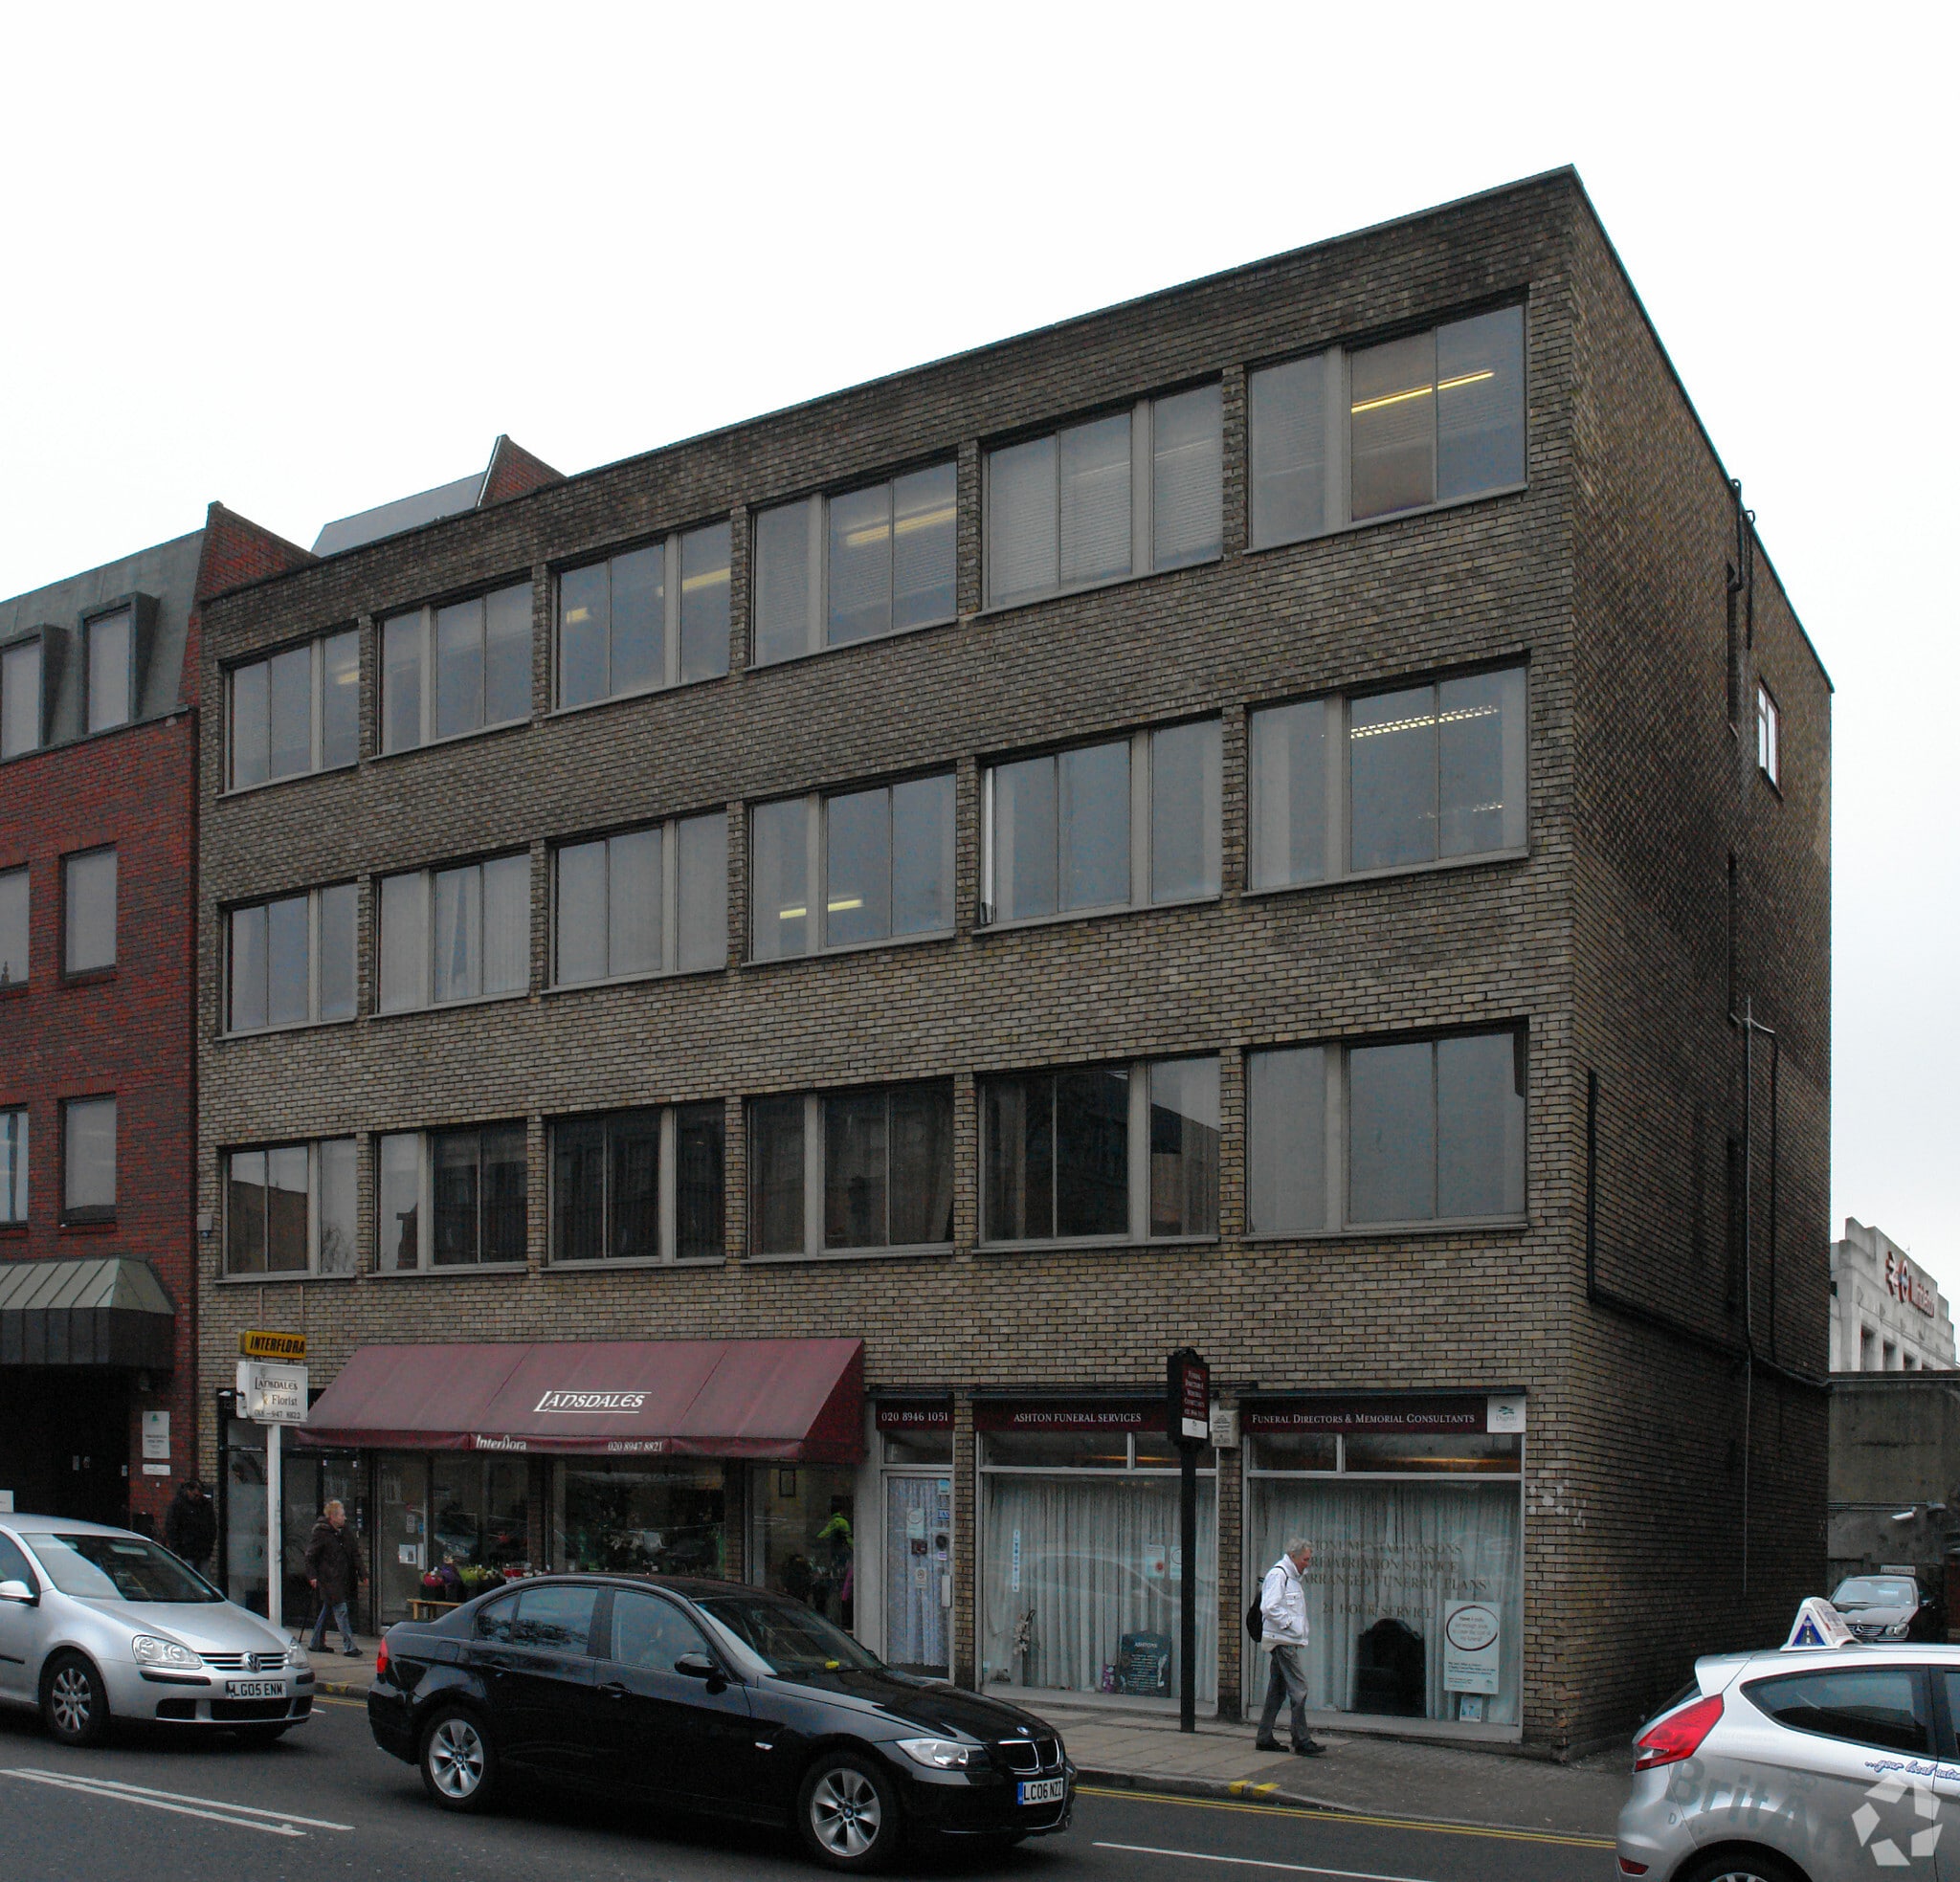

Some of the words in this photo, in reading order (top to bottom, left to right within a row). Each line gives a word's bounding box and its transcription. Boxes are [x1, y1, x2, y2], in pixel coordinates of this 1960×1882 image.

[250, 1336, 305, 1355] INTERFLORA
[255, 1377, 298, 1390] LANSDALES
[272, 1394, 298, 1406] Florist
[533, 1390, 646, 1412] LANSDALES
[880, 1411, 900, 1422] 020
[902, 1411, 924, 1422] 8946
[927, 1411, 948, 1422] 1051
[1013, 1413, 1052, 1423] ASHTON
[1054, 1413, 1096, 1423] FUNERAL
[1098, 1413, 1142, 1423] SERVICES
[1252, 1414, 1291, 1424] FUNERAL
[1292, 1414, 1343, 1424] DIRECTORS
[1345, 1414, 1352, 1424] &
[1355, 1414, 1404, 1424] MEMORIAL
[1406, 1413, 1475, 1424] CONSULTANTS
[475, 1434, 527, 1451] Interflora
[608, 1441, 622, 1451] 020
[623, 1442, 643, 1451] 8947
[644, 1441, 663, 1451] 8821
[1404, 1560, 1459, 1572] SERVICE
[1444, 1578, 1488, 1591] PLANS
[1381, 1605, 1435, 1619] SERVICE
[234, 1683, 262, 1696] LG05
[1904, 1760, 1937, 1776] local
[1023, 1782, 1049, 1801] LC06
[1049, 1781, 1061, 1798] NZZ
